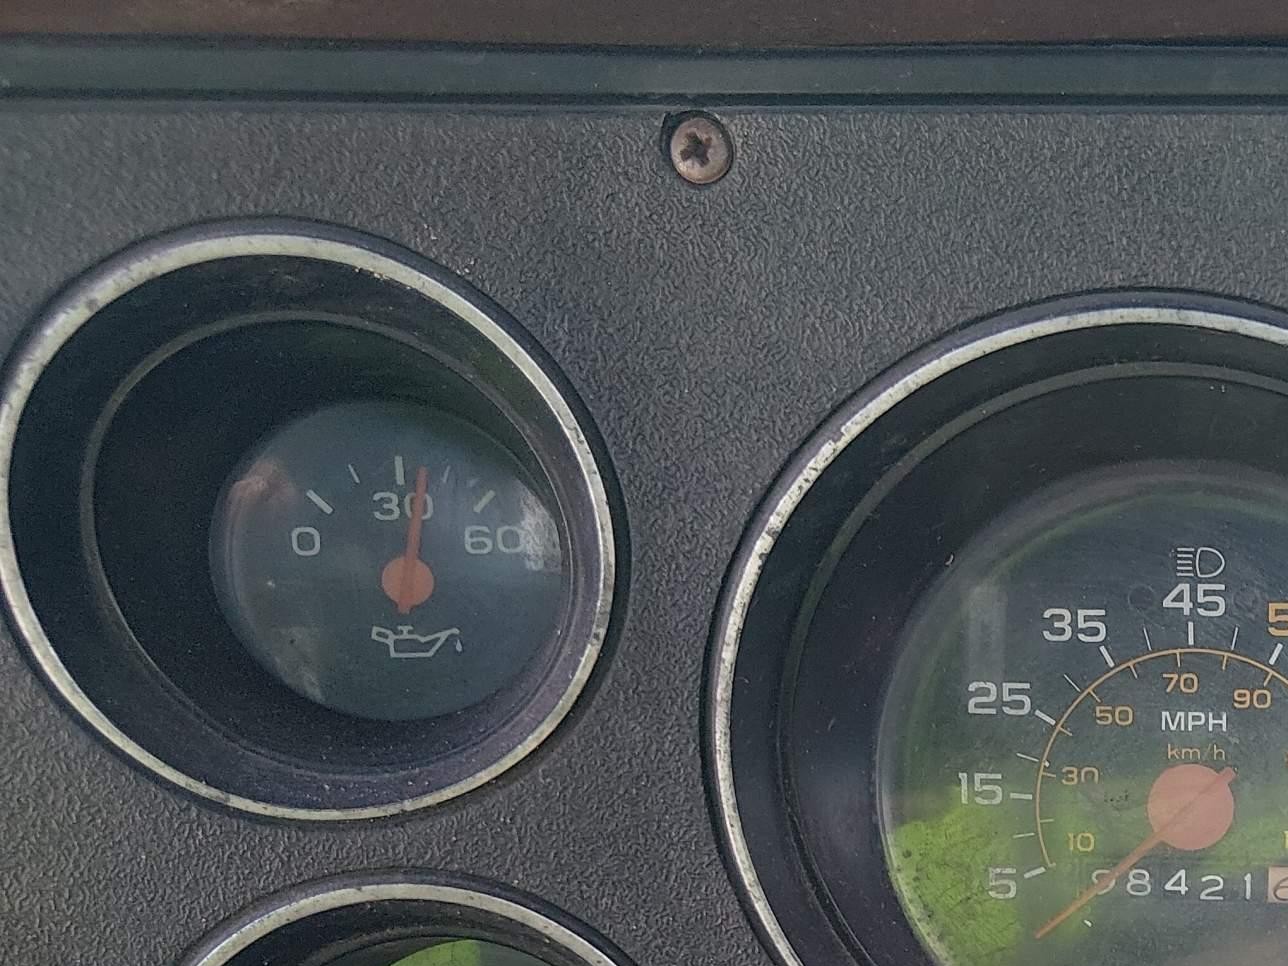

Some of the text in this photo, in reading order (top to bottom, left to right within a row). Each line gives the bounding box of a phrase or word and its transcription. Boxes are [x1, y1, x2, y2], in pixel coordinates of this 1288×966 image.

[372, 492, 434, 521] 30
[291, 527, 321, 556] 0
[464, 526, 526, 554] 60
[1162, 583, 1227, 617] 45
[1042, 608, 1107, 643] 35
[1162, 673, 1199, 694] 70
[967, 681, 1031, 716] 25
[1233, 689, 1272, 710] 90
[1095, 706, 1134, 727] 50
[1160, 711, 1227, 732] MPH
[1167, 744, 1226, 761] km/h
[958, 773, 1003, 806] 15
[1061, 767, 1100, 787] 30
[1066, 832, 1095, 854] 10
[987, 867, 1017, 899] 5
